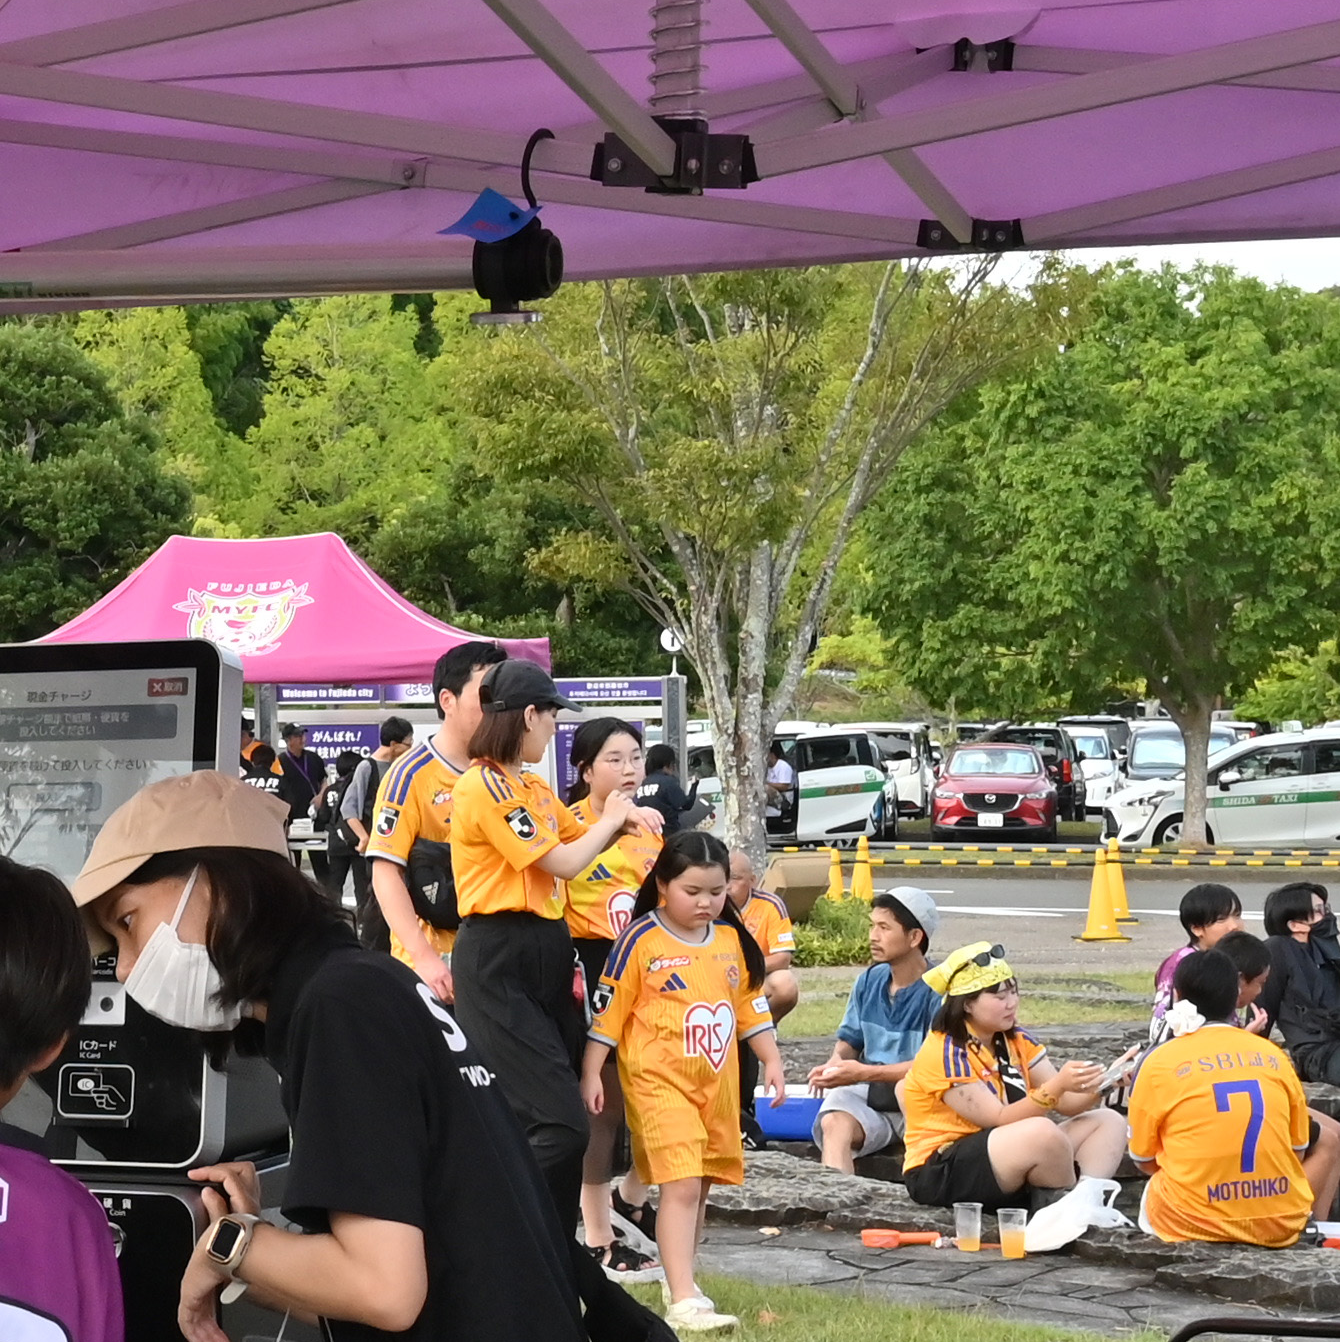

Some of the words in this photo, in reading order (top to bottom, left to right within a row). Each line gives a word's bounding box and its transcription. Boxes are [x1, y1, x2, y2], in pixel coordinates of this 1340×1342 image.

[207, 579, 295, 593] FUJIEDA
[26, 690, 93, 703] 現金チャージ
[282, 688, 318, 698] Welcome
[319, 688, 327, 698] to
[358, 688, 374, 699] city
[19, 726, 96, 737] 投入してください
[1222, 796, 1256, 806] SHIDA
[1272, 793, 1299, 804] TAXI
[684, 1022, 723, 1055] IRIS
[79, 1040, 117, 1051] ICカード
[1212, 1079, 1265, 1174] 7
[1207, 1176, 1289, 1203] MOTOHIKO
